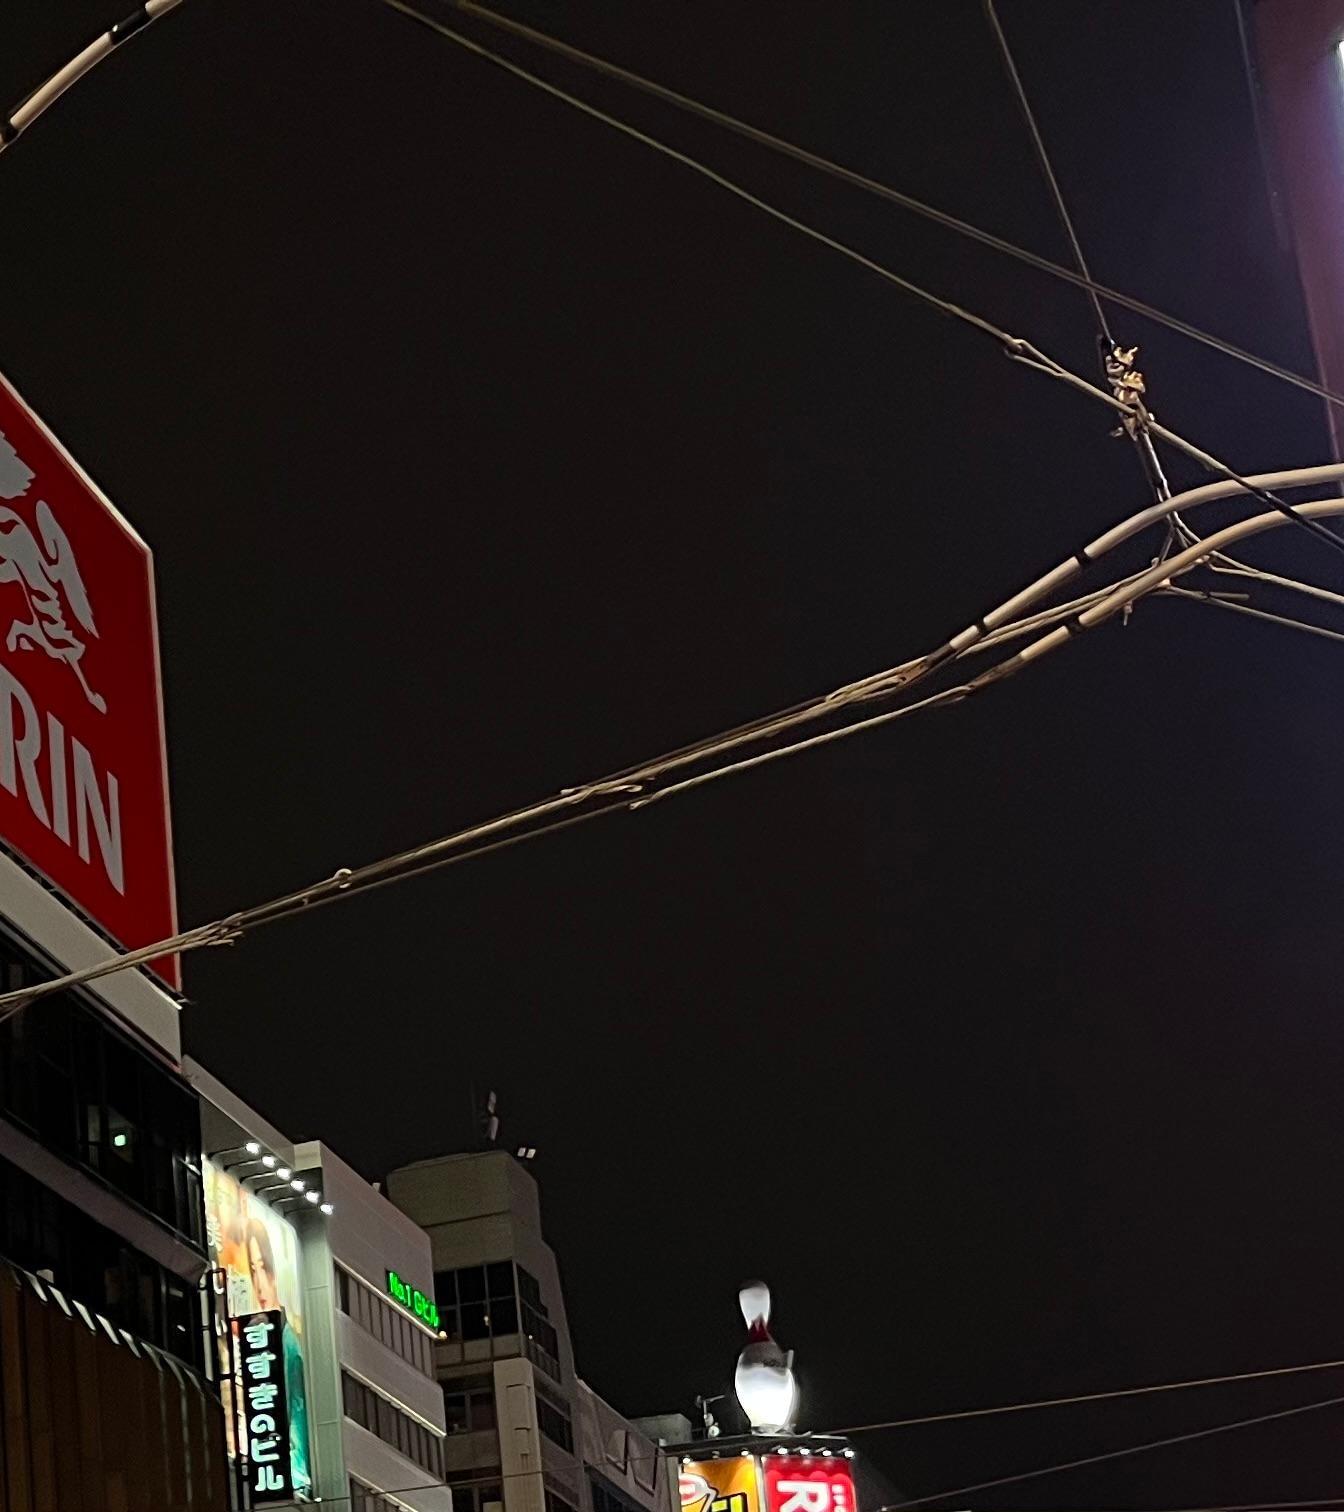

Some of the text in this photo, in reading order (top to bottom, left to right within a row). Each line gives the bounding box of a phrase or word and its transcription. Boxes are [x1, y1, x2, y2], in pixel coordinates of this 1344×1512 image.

[243, 1322, 285, 1493] すすきのビル
